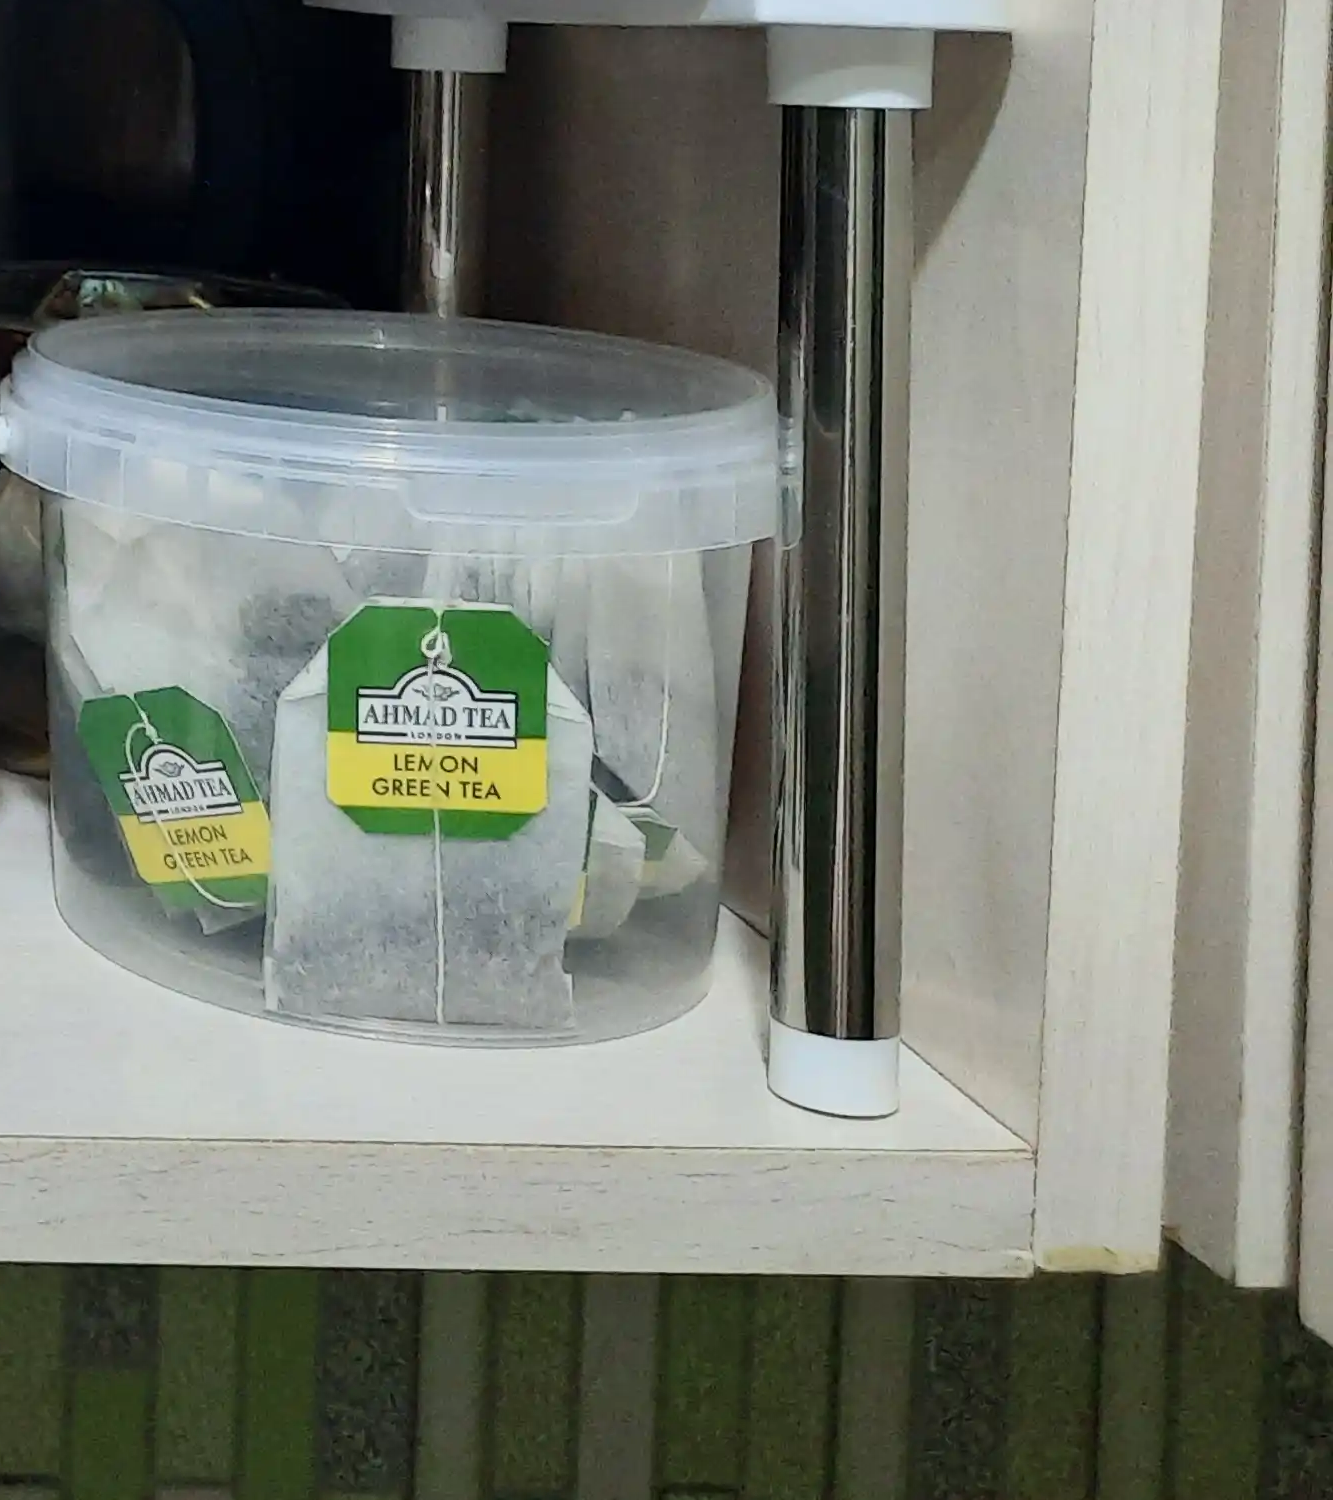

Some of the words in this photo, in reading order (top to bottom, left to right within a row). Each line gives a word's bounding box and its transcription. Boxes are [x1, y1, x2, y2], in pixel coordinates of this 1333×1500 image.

[363, 703, 458, 728] AHMAD
[462, 707, 511, 730] TEA
[393, 753, 479, 775] LEMON
[133, 780, 195, 807] AHMAD
[194, 777, 232, 799] TEA
[372, 777, 451, 798] GREEN
[459, 781, 502, 800] TEA
[167, 824, 228, 846] LEMON
[219, 848, 253, 865] TEA
